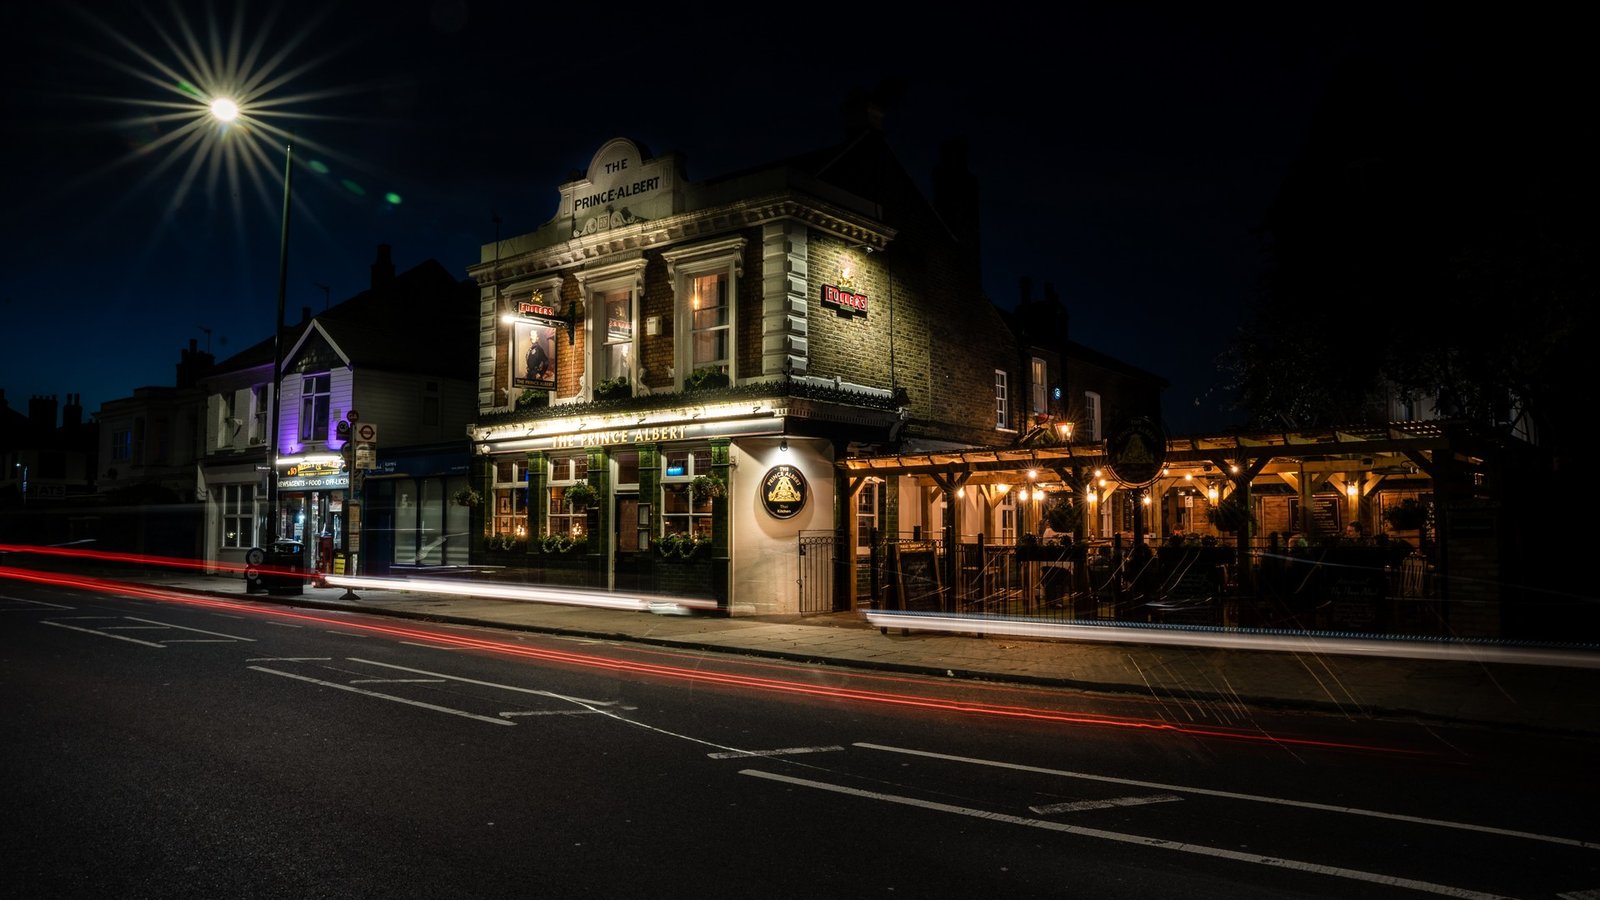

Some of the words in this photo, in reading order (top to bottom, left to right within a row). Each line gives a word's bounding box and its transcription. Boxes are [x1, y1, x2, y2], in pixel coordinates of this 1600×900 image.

[605, 158, 628, 174] THE
[552, 434, 576, 448] THE
[580, 429, 628, 446] PRINCE
[634, 425, 687, 442] ALBERT
[309, 479, 322, 487] FOOD
[767, 472, 785, 487] PRINCE
[784, 471, 802, 486] ALBERT
